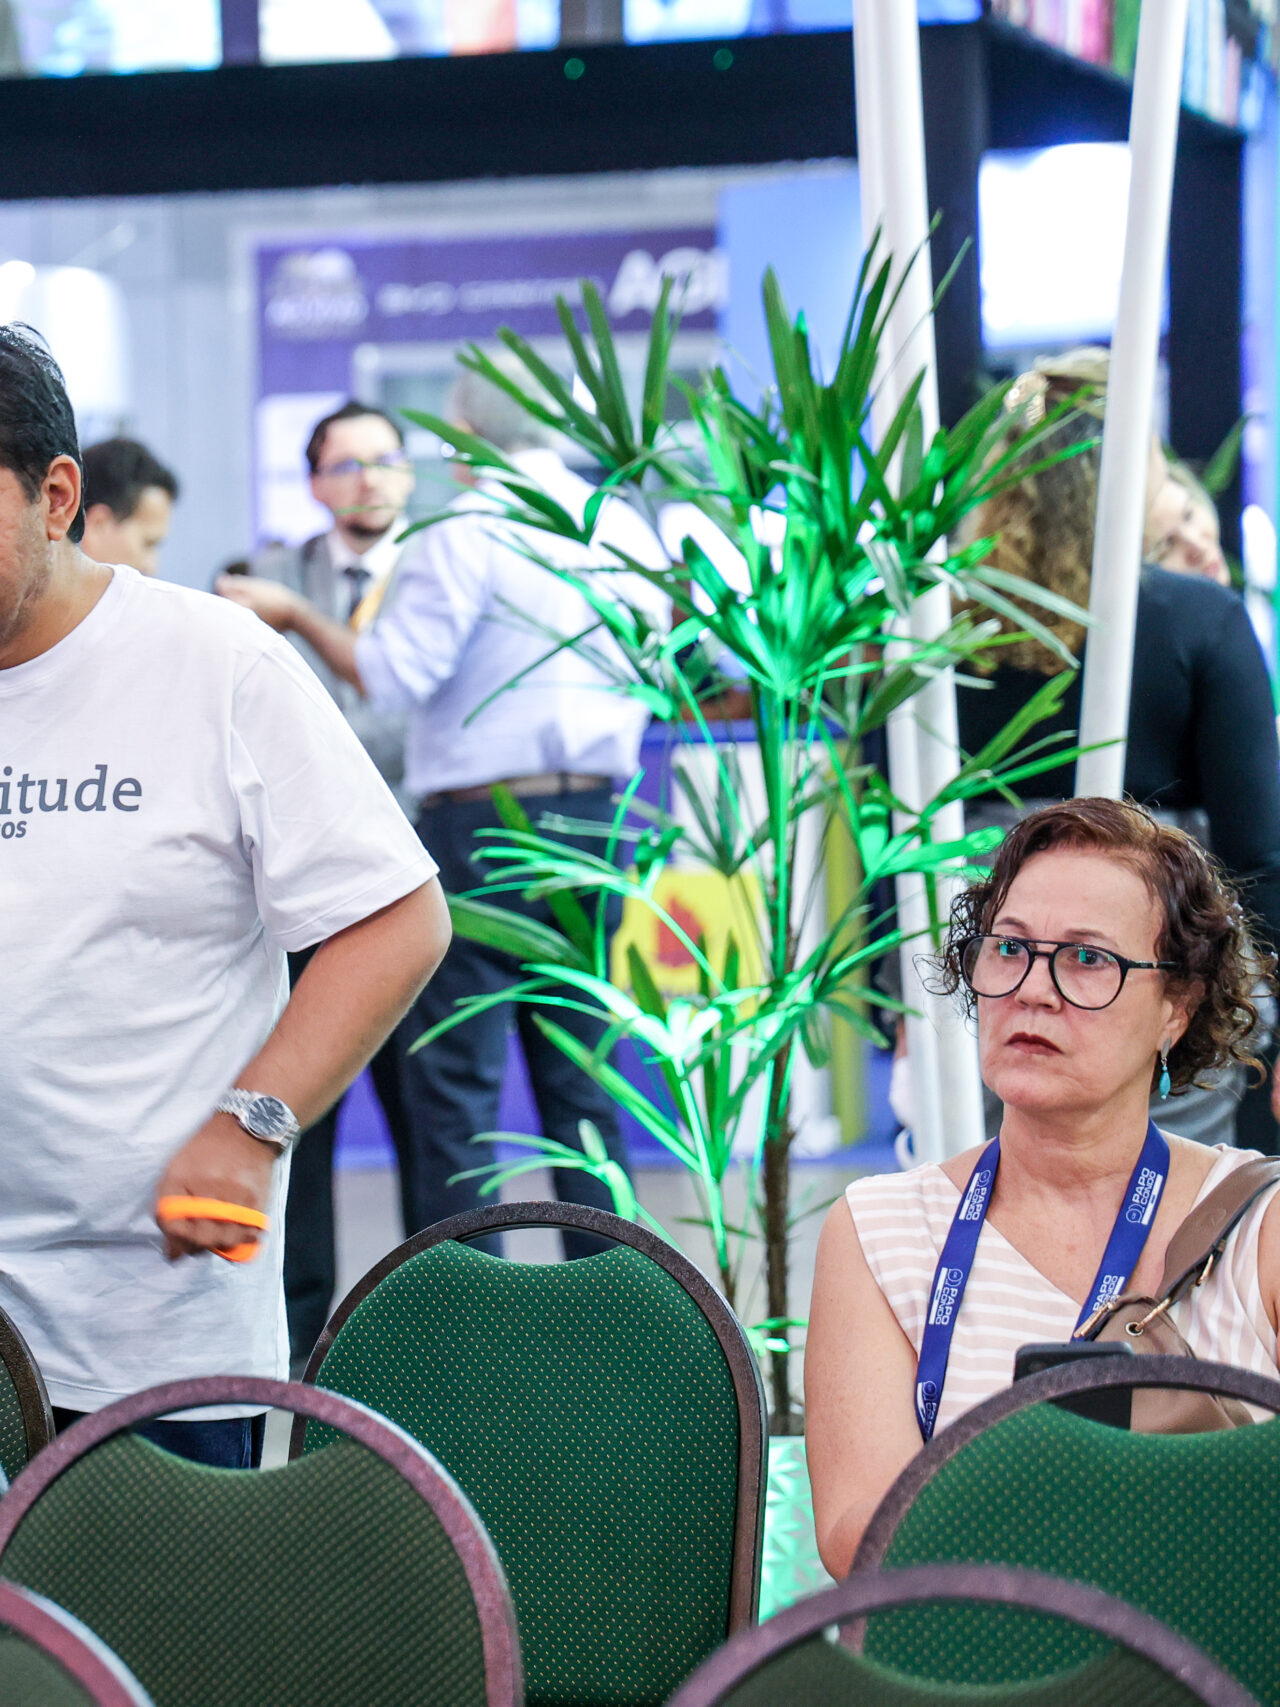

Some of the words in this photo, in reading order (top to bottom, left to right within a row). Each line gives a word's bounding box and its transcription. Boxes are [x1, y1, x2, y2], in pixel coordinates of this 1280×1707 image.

[1132, 1167, 1151, 1204] PAPO
[1140, 1170, 1157, 1205] CONDO
[965, 1188, 981, 1221] CONDO
[971, 1187, 988, 1221] PAPO
[935, 1286, 951, 1325] CONDO
[941, 1287, 959, 1325] PAPO
